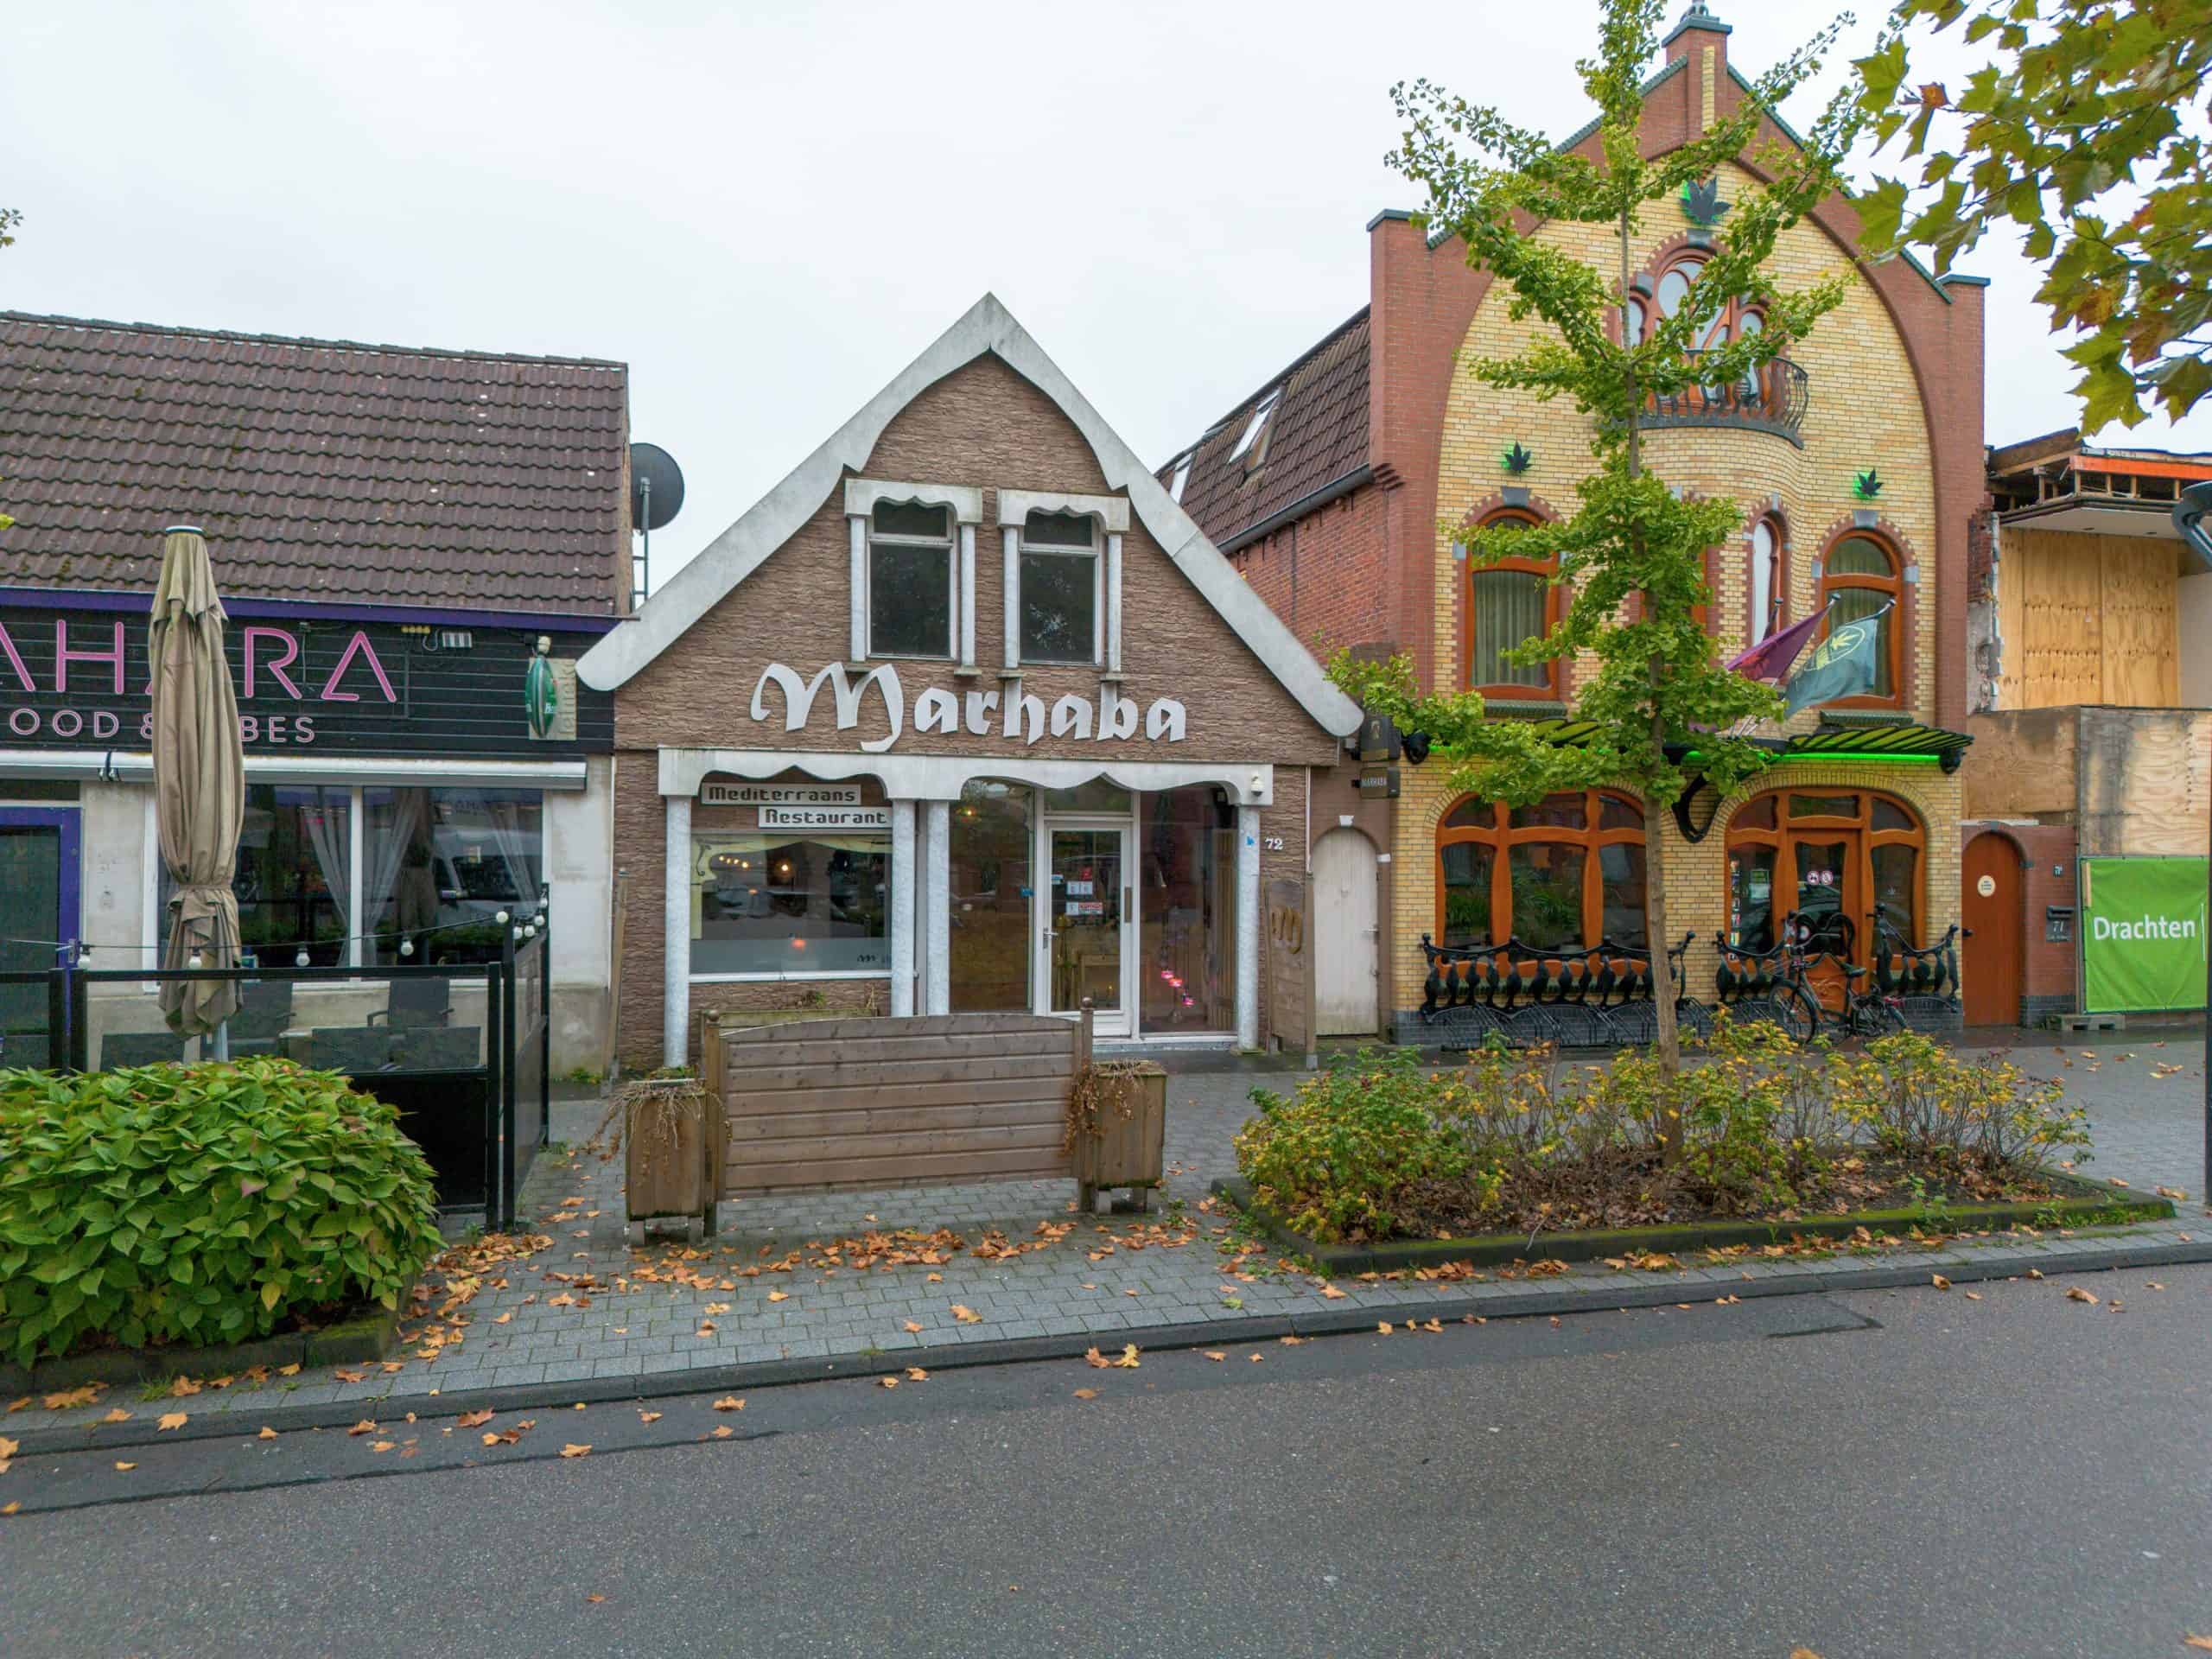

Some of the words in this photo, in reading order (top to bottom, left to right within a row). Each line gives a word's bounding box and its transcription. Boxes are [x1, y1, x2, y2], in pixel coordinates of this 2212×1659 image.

[0, 619, 397, 702] HRA
[750, 662, 1186, 753] Marhaba
[238, 715, 315, 743] BES
[708, 785, 856, 802] Mediterraans
[765, 808, 887, 824] Restaurant
[1264, 836, 1284, 850] 72
[2093, 913, 2196, 941] Drachten
